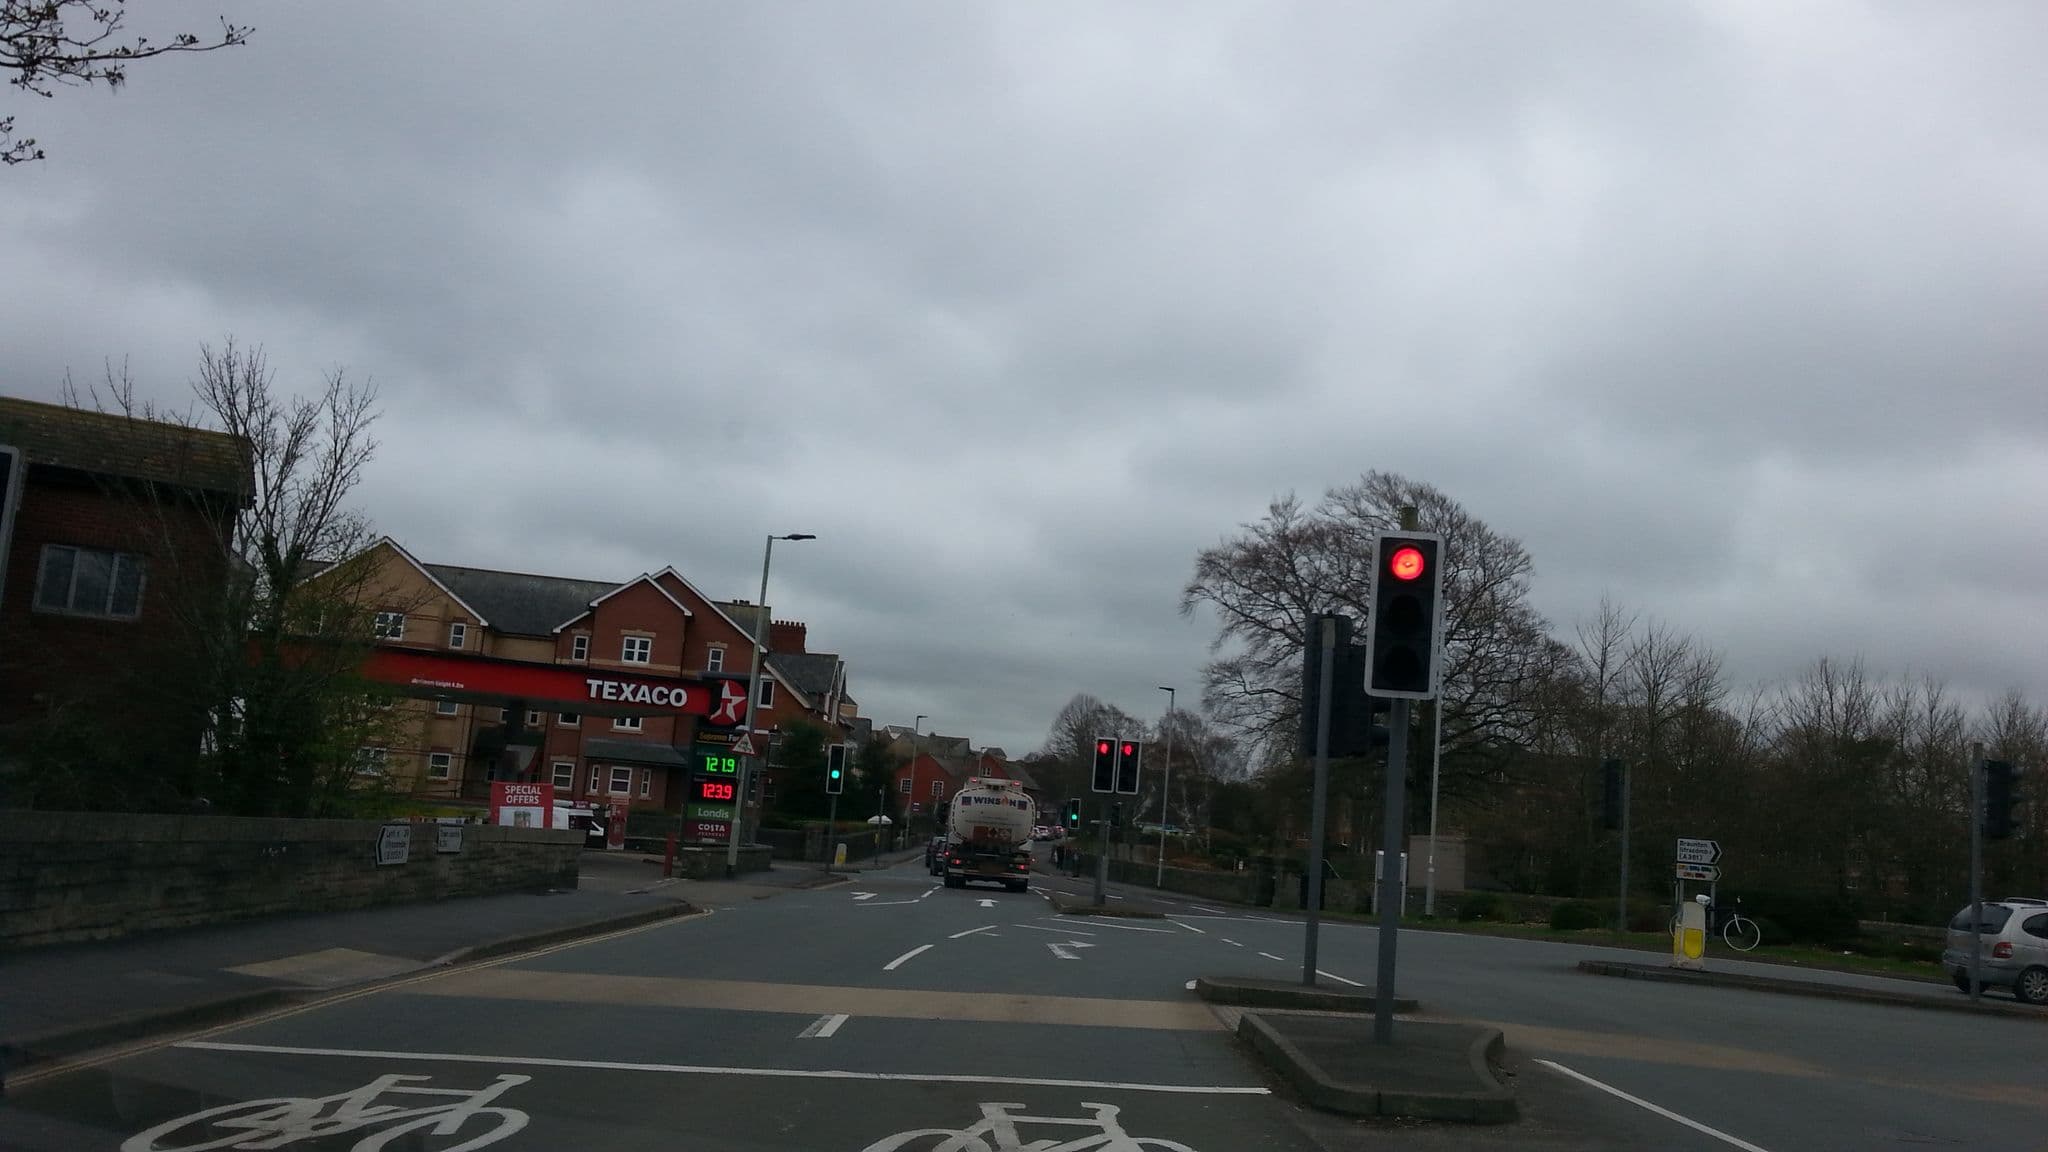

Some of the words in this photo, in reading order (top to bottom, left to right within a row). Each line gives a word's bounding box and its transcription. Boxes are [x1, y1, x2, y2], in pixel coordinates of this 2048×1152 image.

[586, 678, 688, 707] TEXACO
[505, 785, 542, 795] SPECIAL
[506, 795, 539, 804] OFFERS
[698, 808, 729, 819] Londis
[698, 824, 725, 832] COSTA
